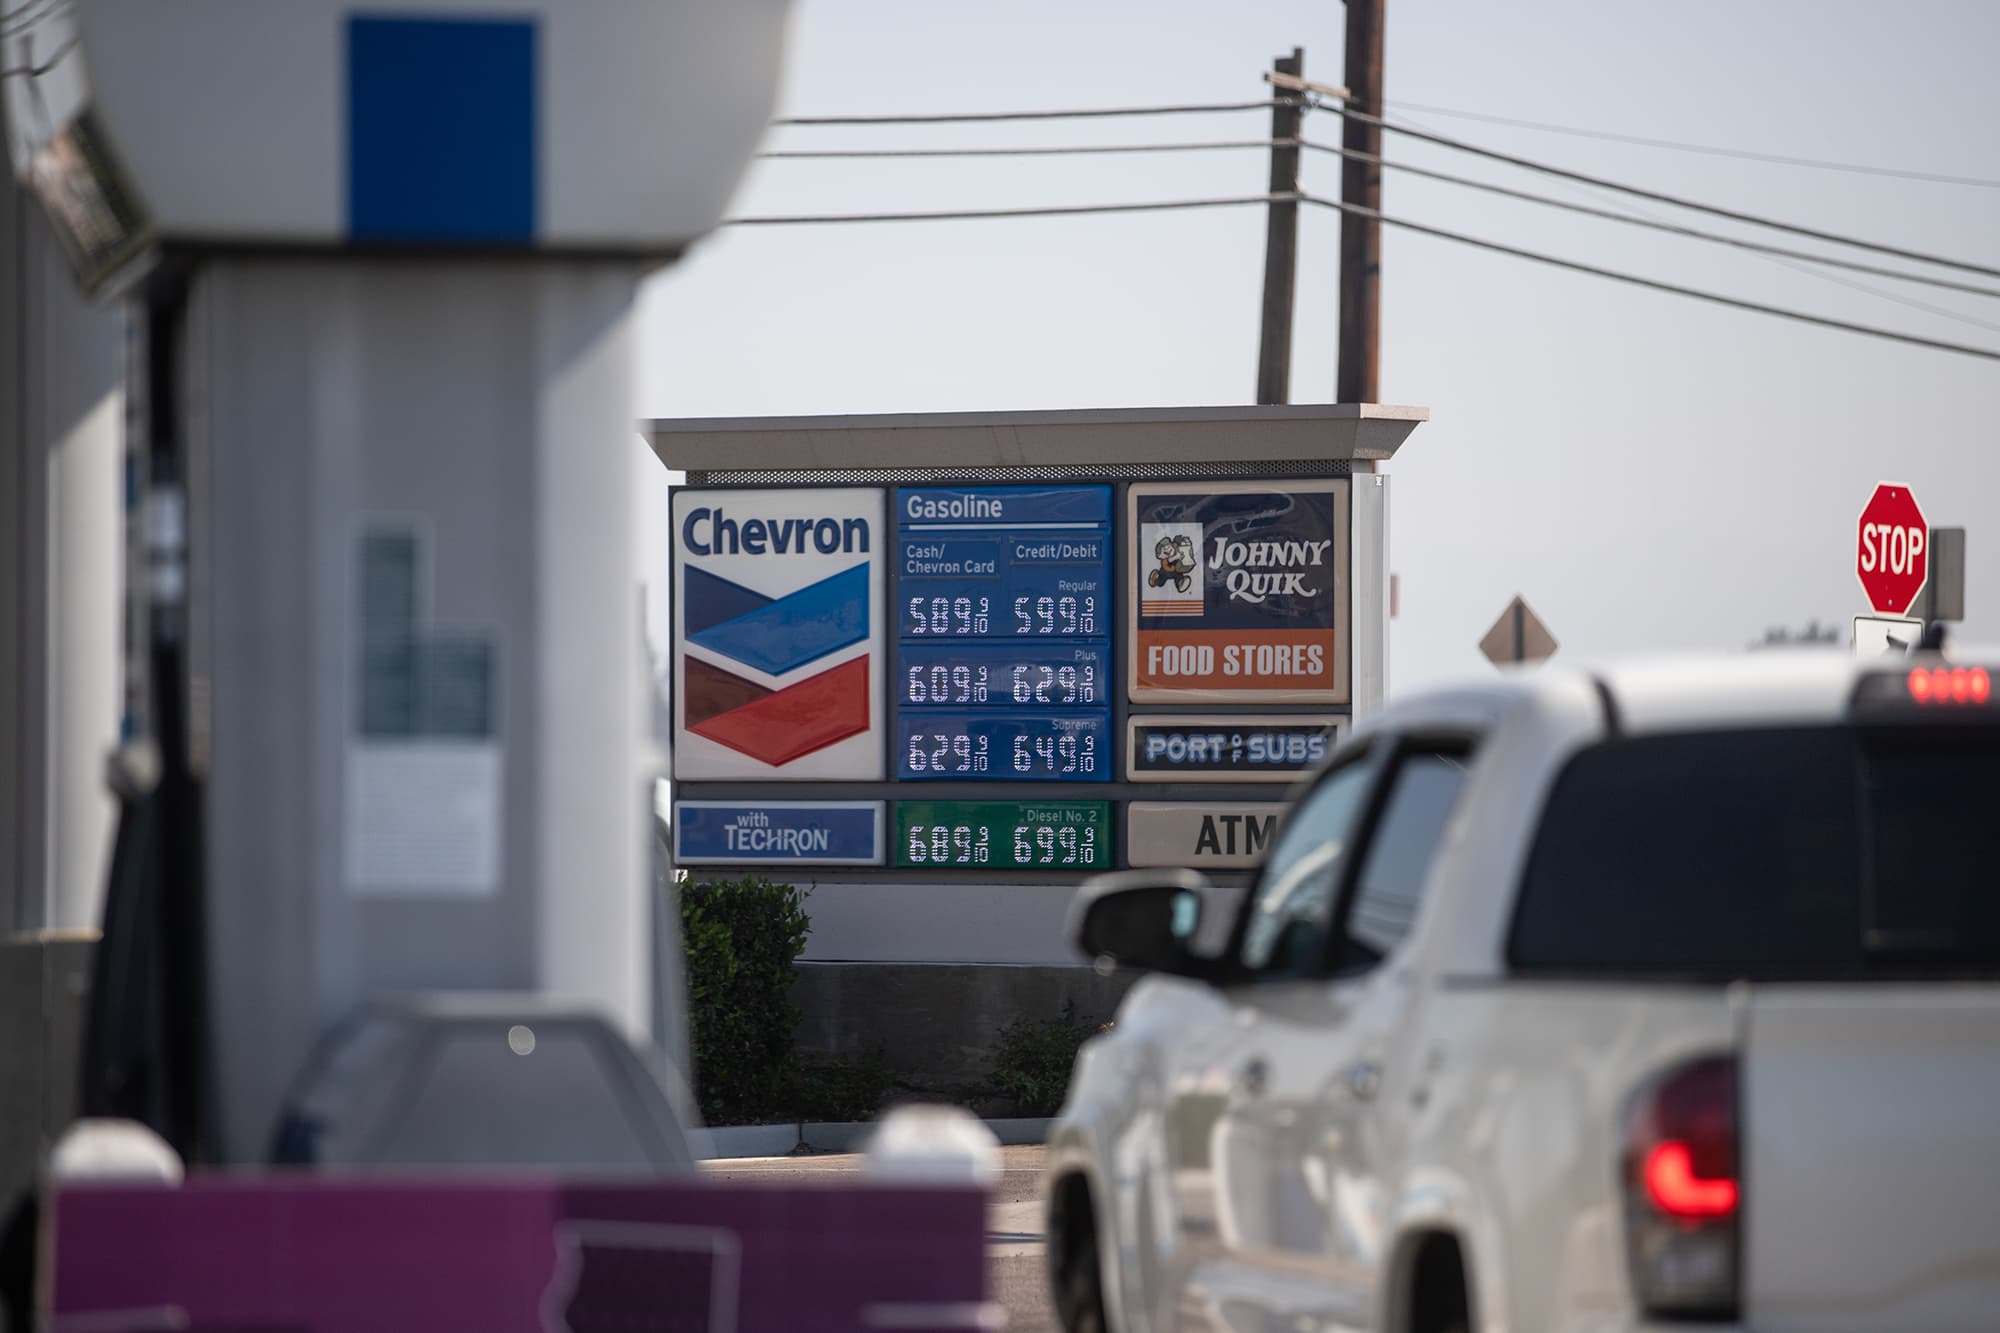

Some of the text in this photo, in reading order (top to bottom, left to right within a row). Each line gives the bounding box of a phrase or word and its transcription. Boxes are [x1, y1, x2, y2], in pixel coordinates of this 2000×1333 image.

[907, 495, 1003, 518] Gasoline
[682, 507, 870, 556] Chevron
[907, 544, 945, 558] Cash/
[1016, 544, 1097, 559] Credit/Debit
[1208, 537, 1331, 569] JOHNNY
[1861, 522, 1924, 575] STOP
[907, 560, 995, 573] Chevron Card
[1059, 580, 1096, 592] Regular
[1226, 569, 1317, 603] QUIK
[1075, 650, 1096, 660] Plus
[1148, 644, 1324, 675] FOOD STORES
[1052, 719, 1096, 731] Supreme
[1147, 735, 1225, 762] PORT
[1248, 734, 1327, 763] SUBS
[737, 812, 769, 827] with
[1027, 809, 1097, 822] Diesel No. 2
[724, 825, 829, 856] TECHRON
[1194, 815, 1277, 855] ATM
